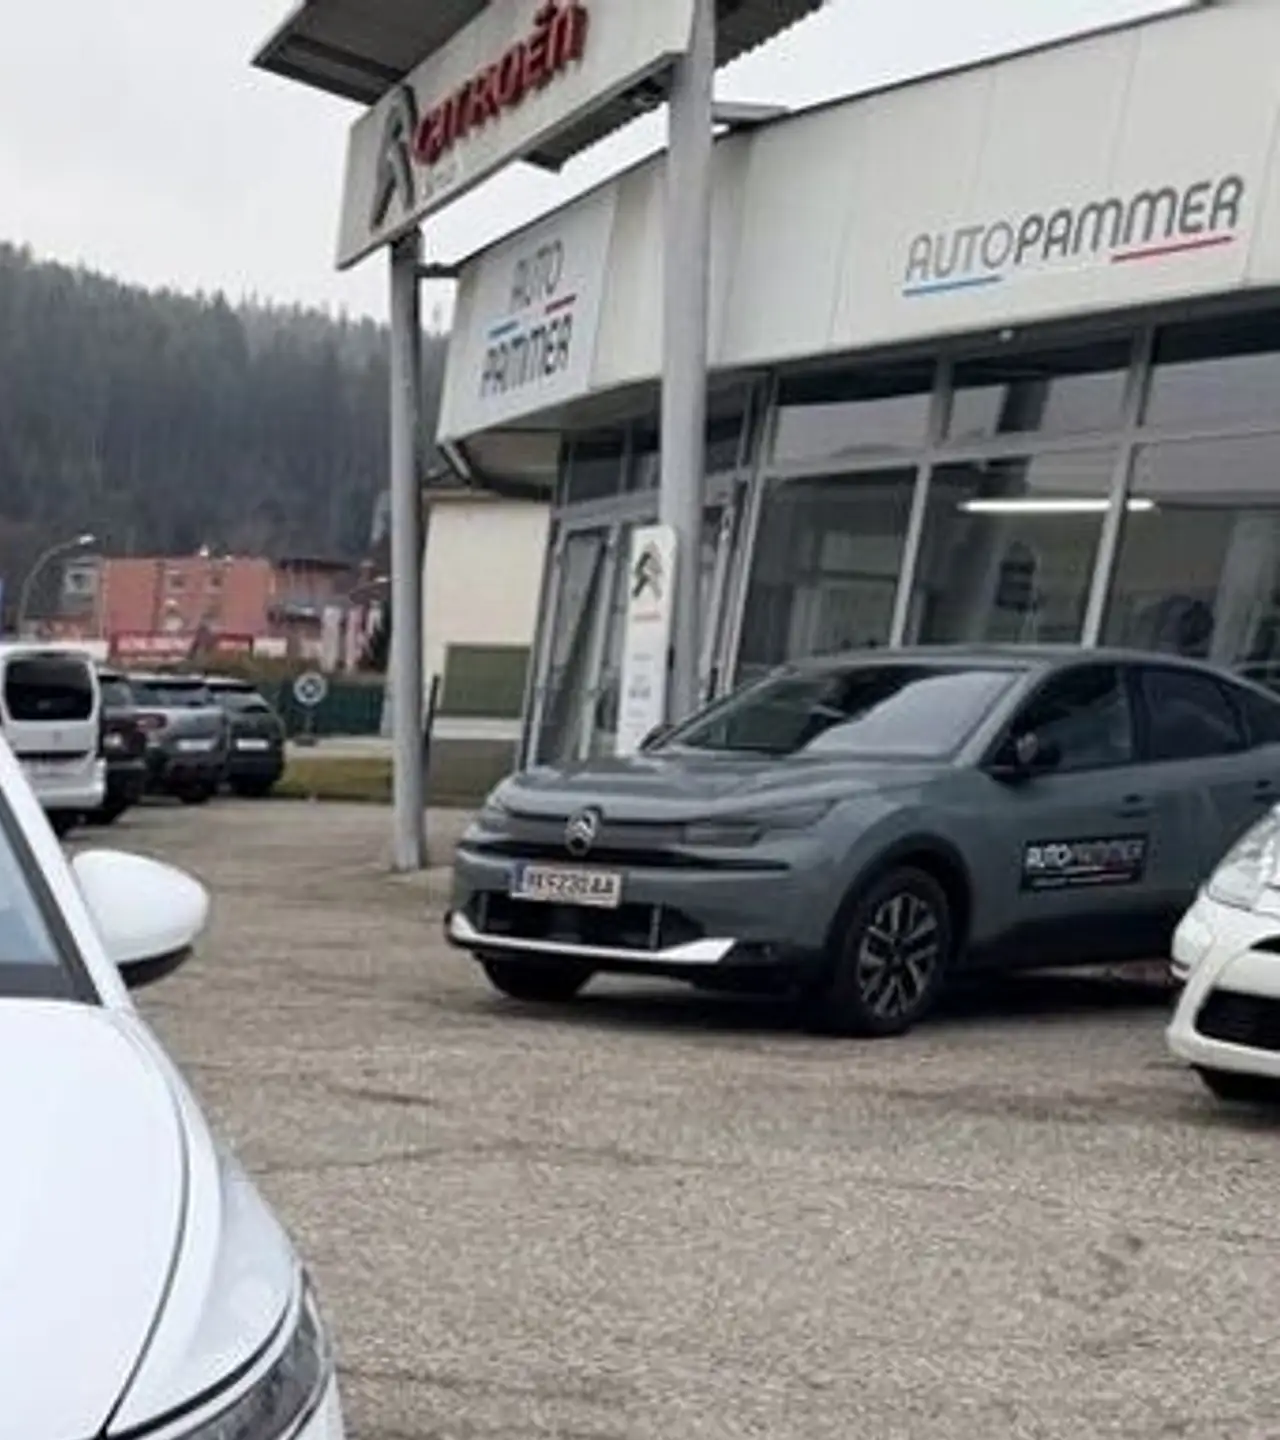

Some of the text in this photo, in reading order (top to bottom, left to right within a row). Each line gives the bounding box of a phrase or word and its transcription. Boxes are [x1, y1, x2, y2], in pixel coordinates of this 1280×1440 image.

[904, 174, 1244, 283] AUTOPAMMER
[509, 240, 564, 313] AUTO
[479, 313, 572, 398] PAMMER
